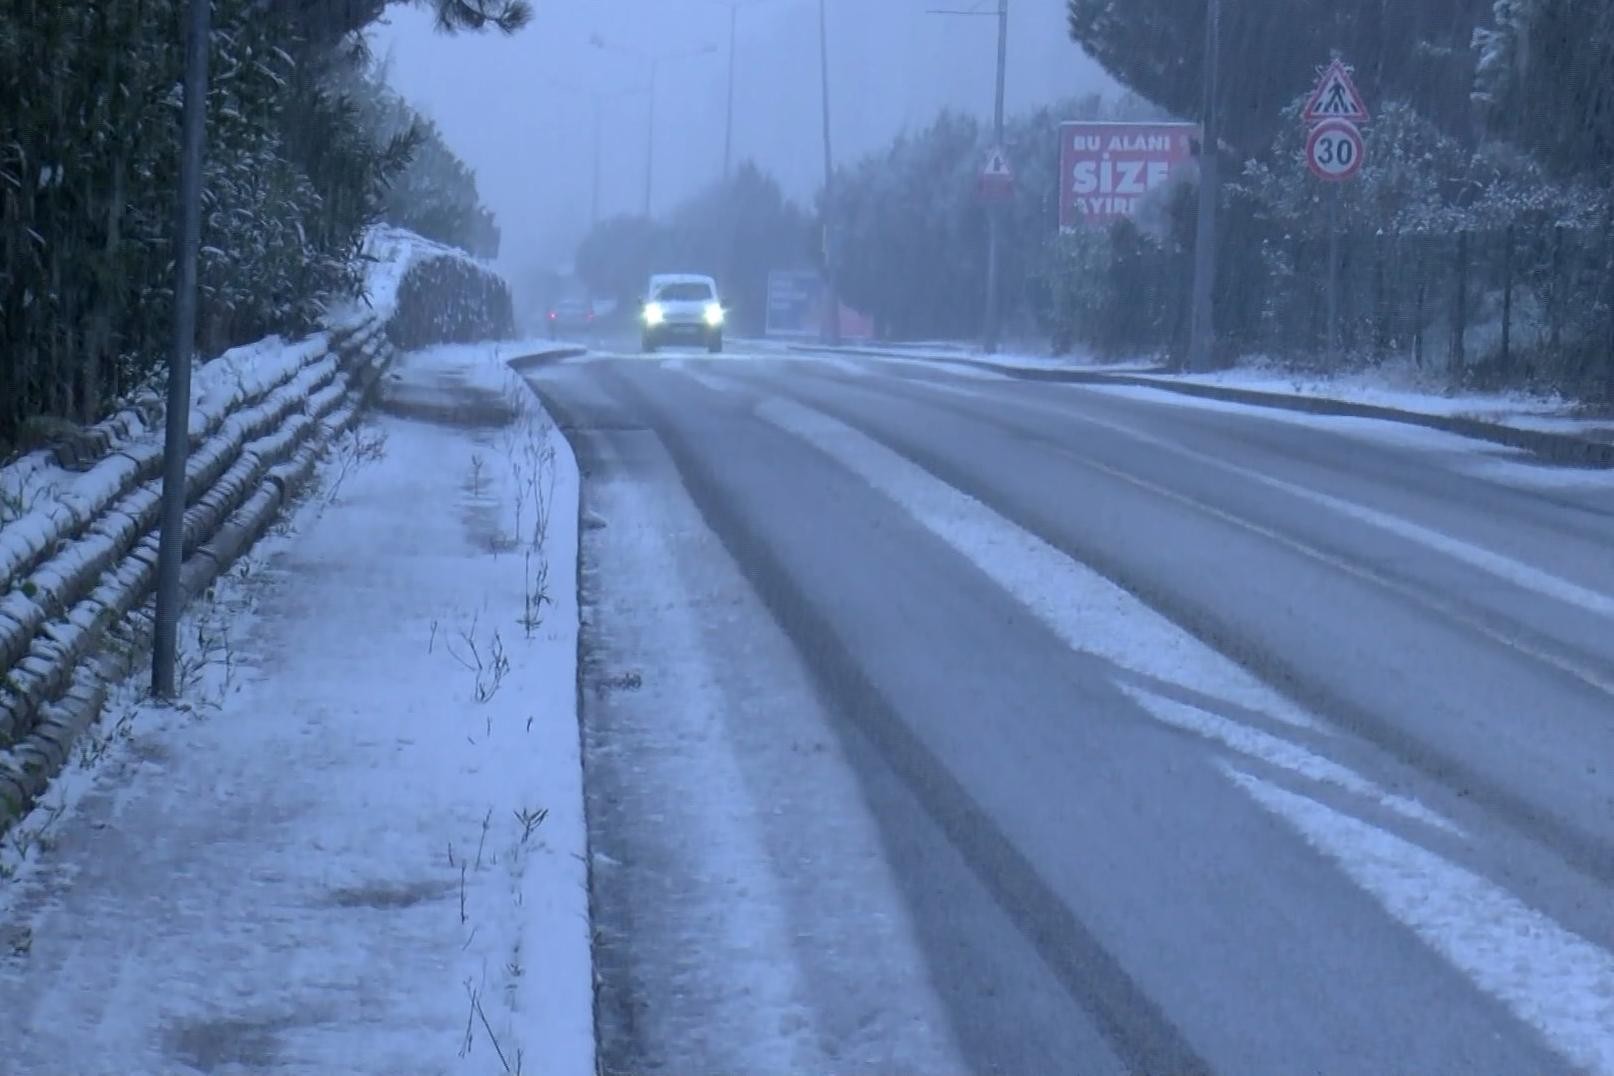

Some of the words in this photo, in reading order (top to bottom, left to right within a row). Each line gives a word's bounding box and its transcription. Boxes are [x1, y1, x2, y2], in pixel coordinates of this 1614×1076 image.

[1073, 135, 1101, 151] BU
[1107, 135, 1170, 151] ALANI
[1317, 138, 1352, 165] 30
